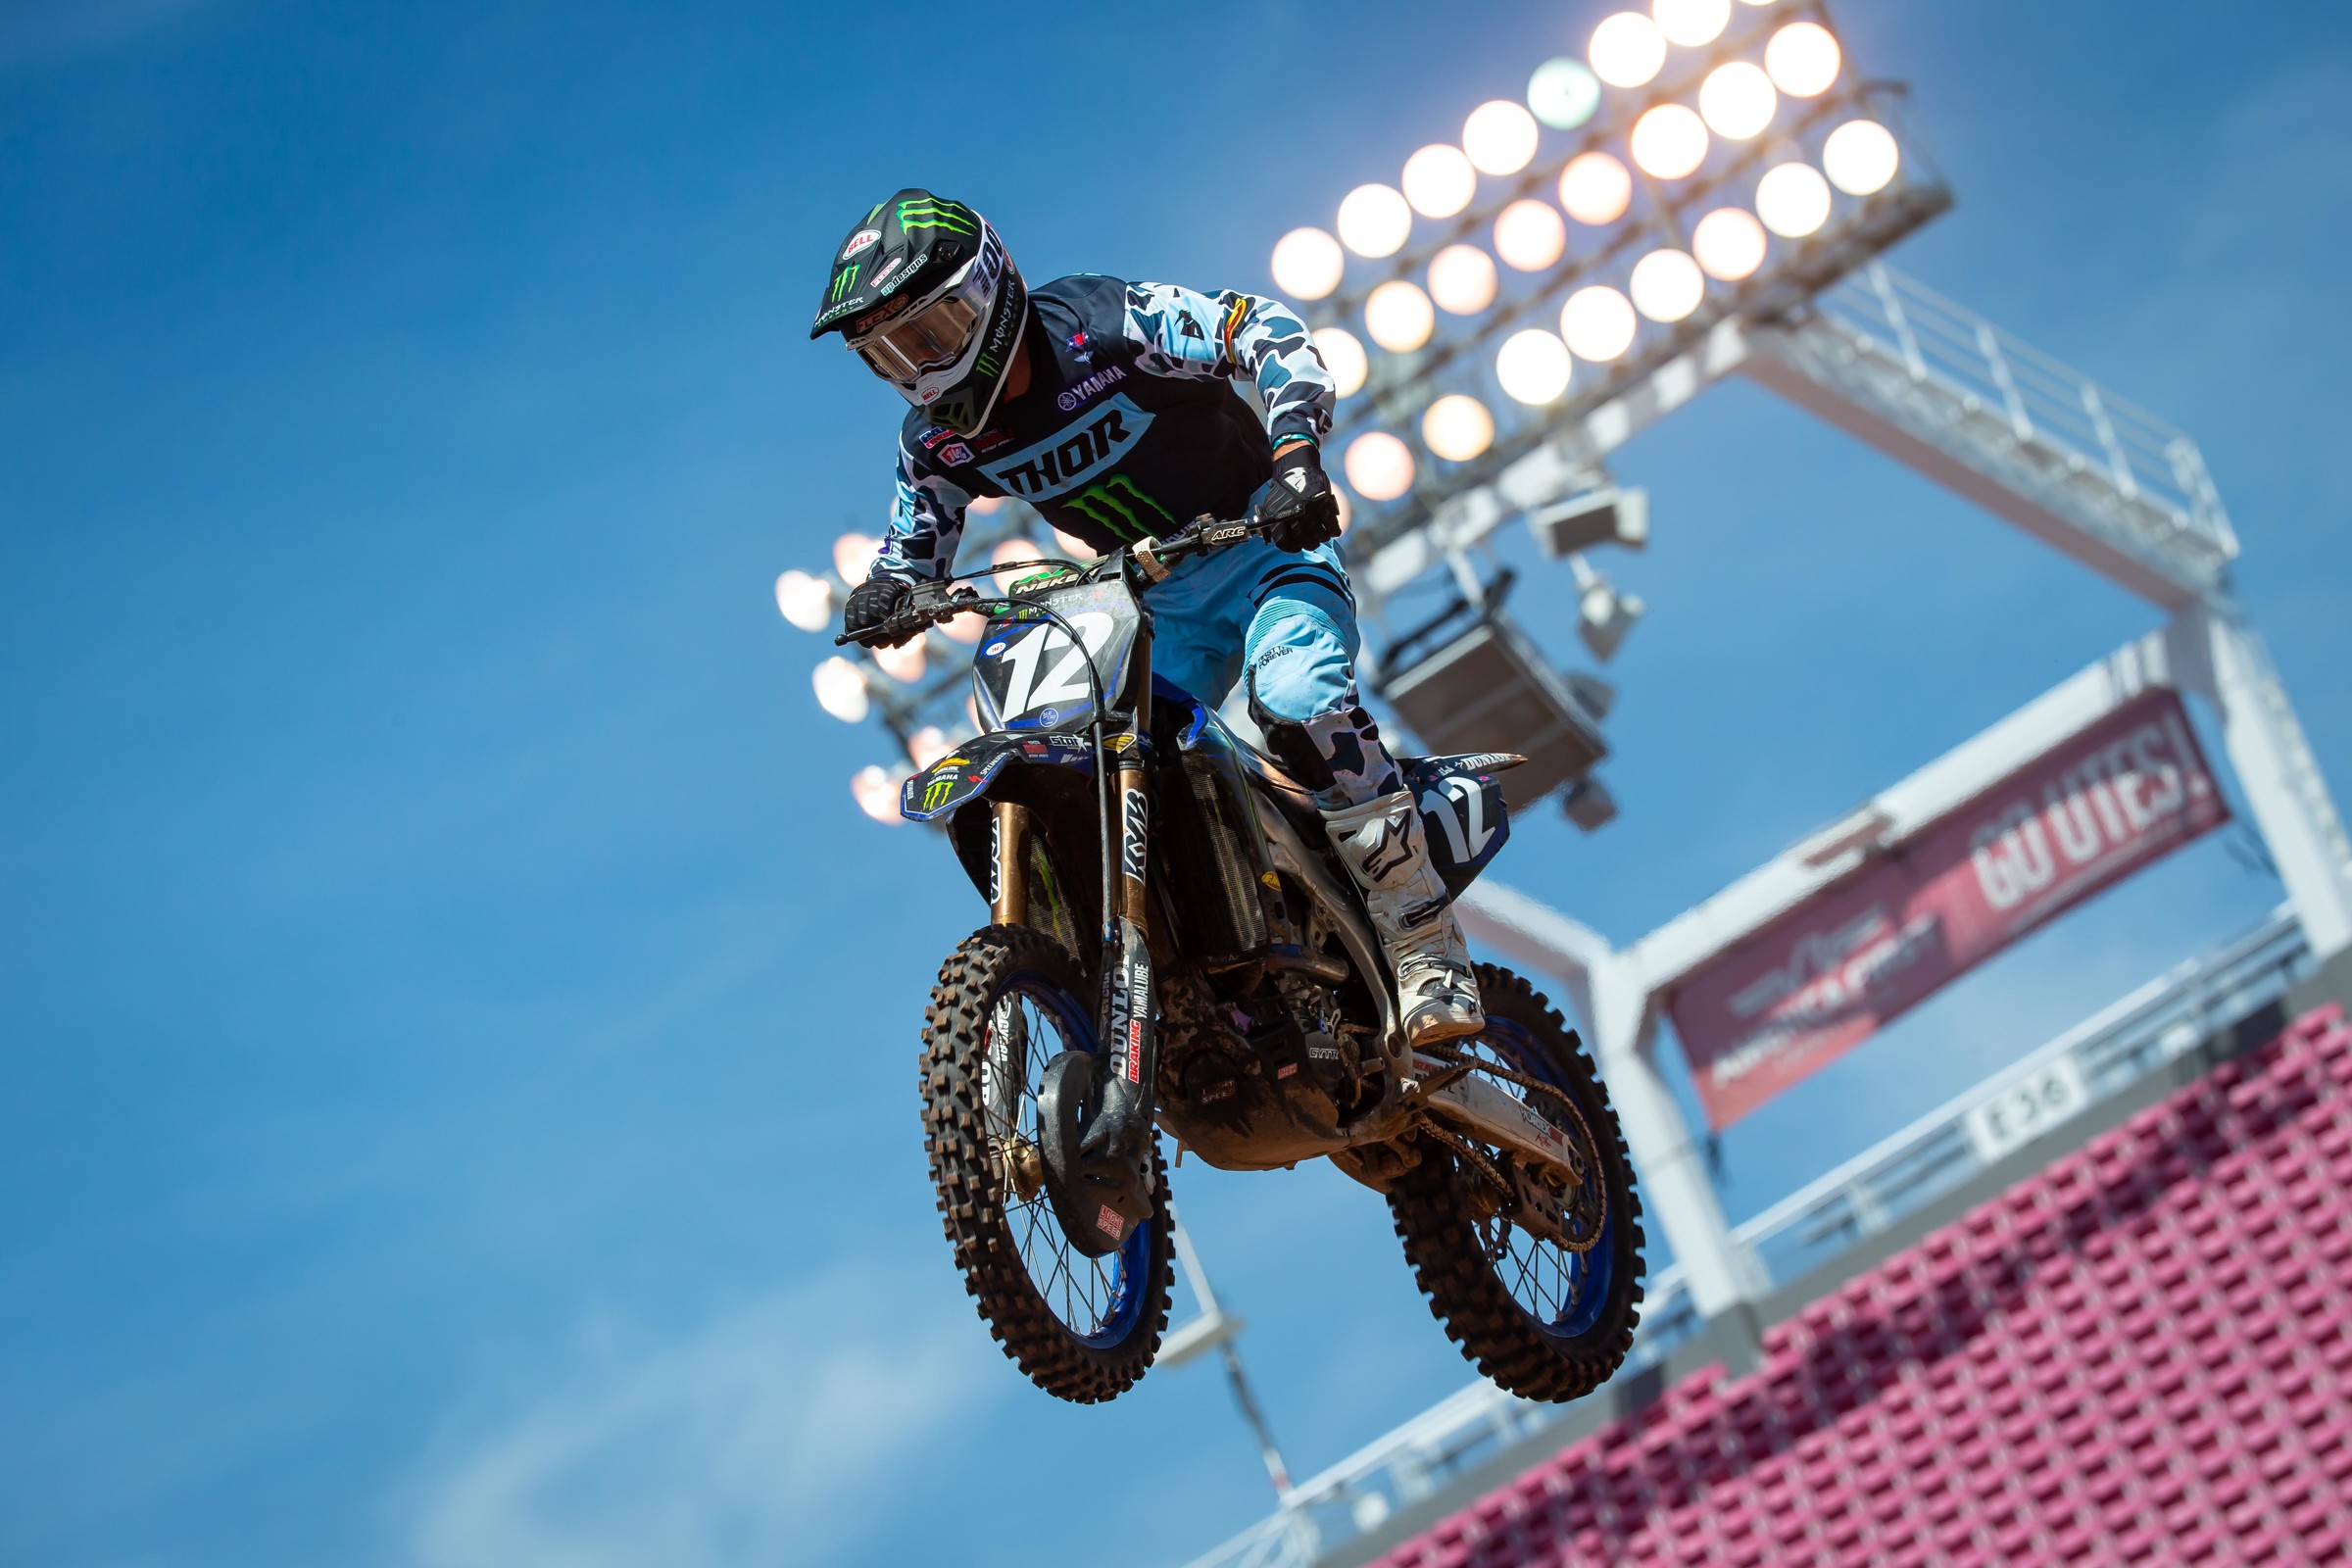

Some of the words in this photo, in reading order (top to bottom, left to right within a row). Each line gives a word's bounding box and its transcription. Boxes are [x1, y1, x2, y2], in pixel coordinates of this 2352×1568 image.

[848, 234, 873, 254] BELL
[881, 253, 928, 296] apdesigns
[989, 279, 1015, 353] MONSTER
[922, 390, 936, 401] BELL
[1071, 365, 1127, 401] YAMAHA
[996, 409, 1132, 495] THOR
[1211, 526, 1246, 541] ARC
[1001, 612, 1114, 724] 12
[1258, 647, 1293, 670] FOREVER
[1460, 753, 1511, 771] DUNLOP
[1123, 788, 1149, 886] KYB
[1419, 776, 1496, 864] 12
[1133, 962, 1150, 1019] YAMALUBE
[1128, 1018, 1142, 1084] BRAKING
[1309, 1047, 1340, 1060] GYTR
[1097, 1218, 1122, 1241] SPEED
[1100, 1205, 1125, 1226] LIGHT
